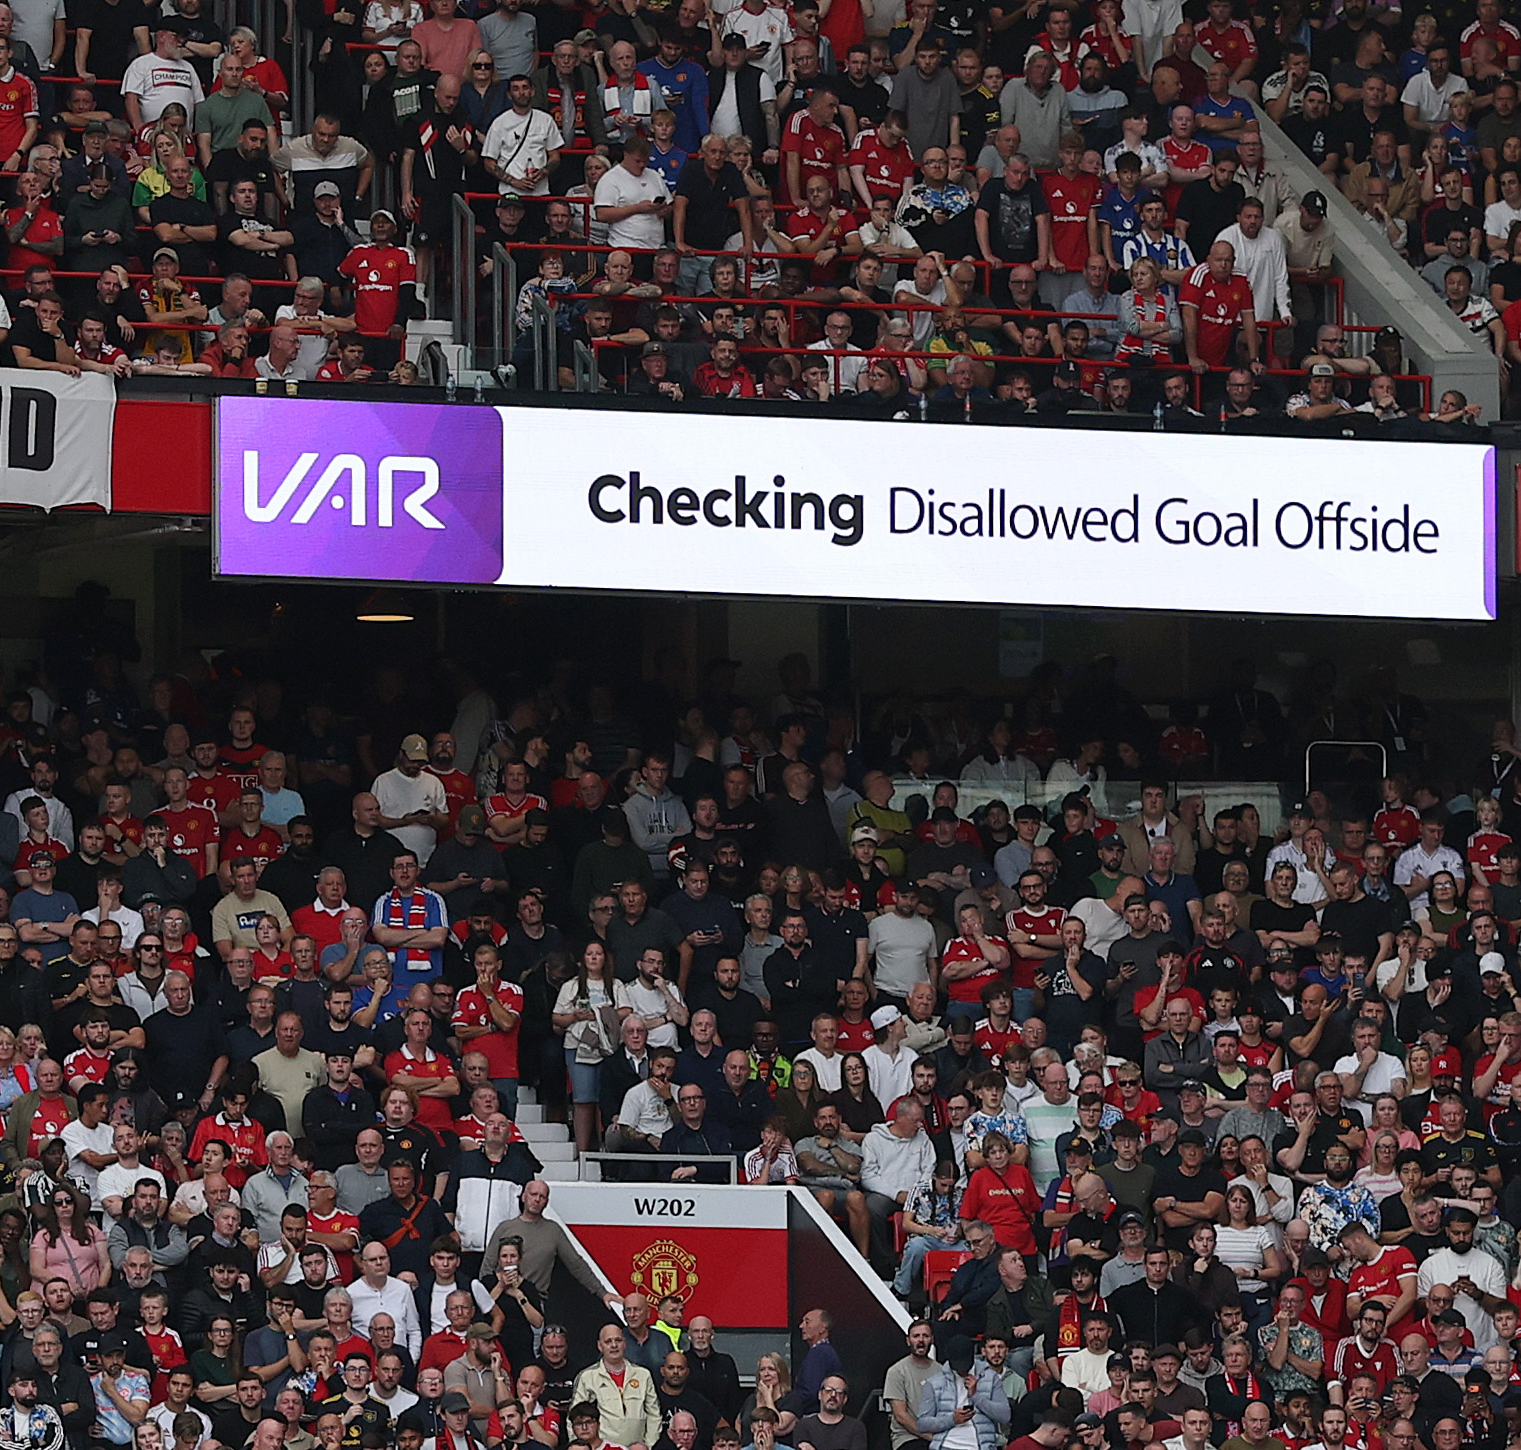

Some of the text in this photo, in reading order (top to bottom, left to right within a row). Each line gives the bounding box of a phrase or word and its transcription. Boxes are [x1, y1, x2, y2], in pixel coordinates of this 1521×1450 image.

[358, 283, 393, 292] Snapdragon
[243, 450, 446, 529] VAR
[587, 470, 1440, 554] Checking Disallowed Goal Offside
[634, 1198, 695, 1217] W202
[638, 1246, 692, 1271] MANCHESTER
